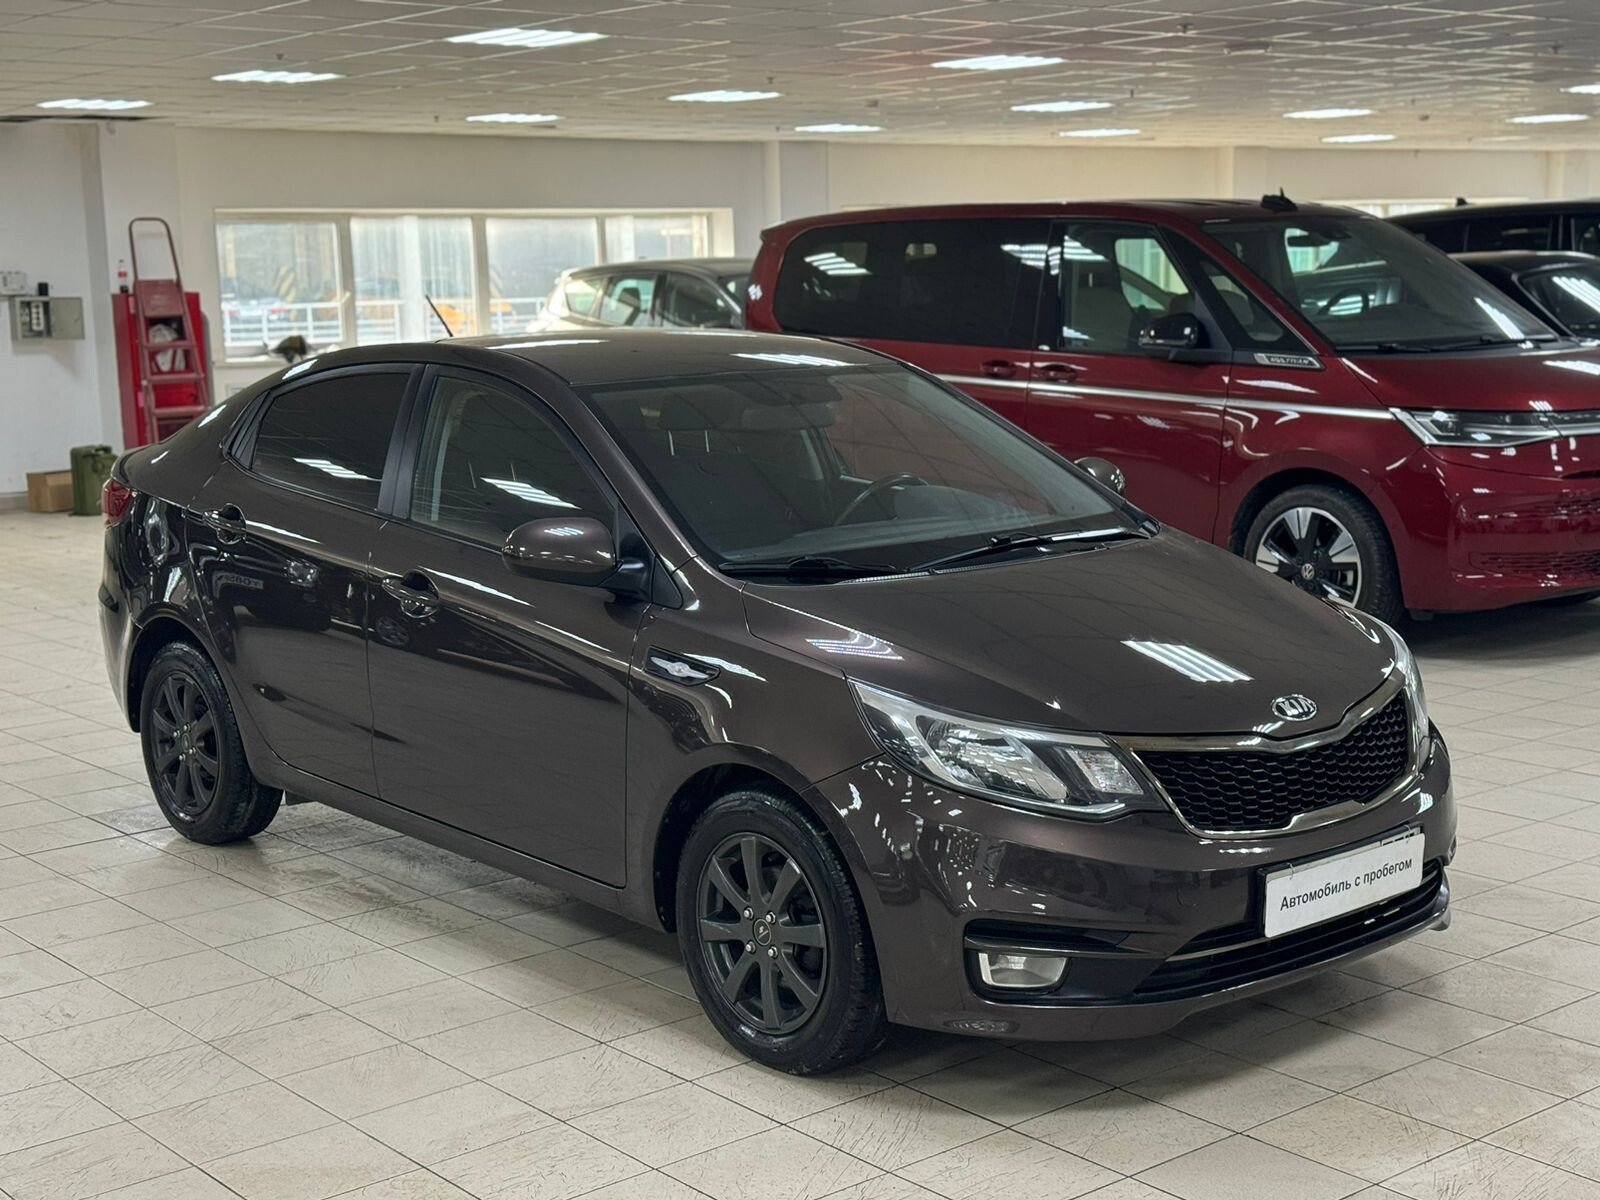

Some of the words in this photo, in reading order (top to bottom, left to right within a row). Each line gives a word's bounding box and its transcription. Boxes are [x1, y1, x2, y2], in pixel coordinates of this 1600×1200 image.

[1276, 697, 1315, 717] KIA
[1279, 880, 1352, 911] Автомобиль
[1354, 876, 1361, 887] с
[1363, 857, 1413, 885] пробегом
